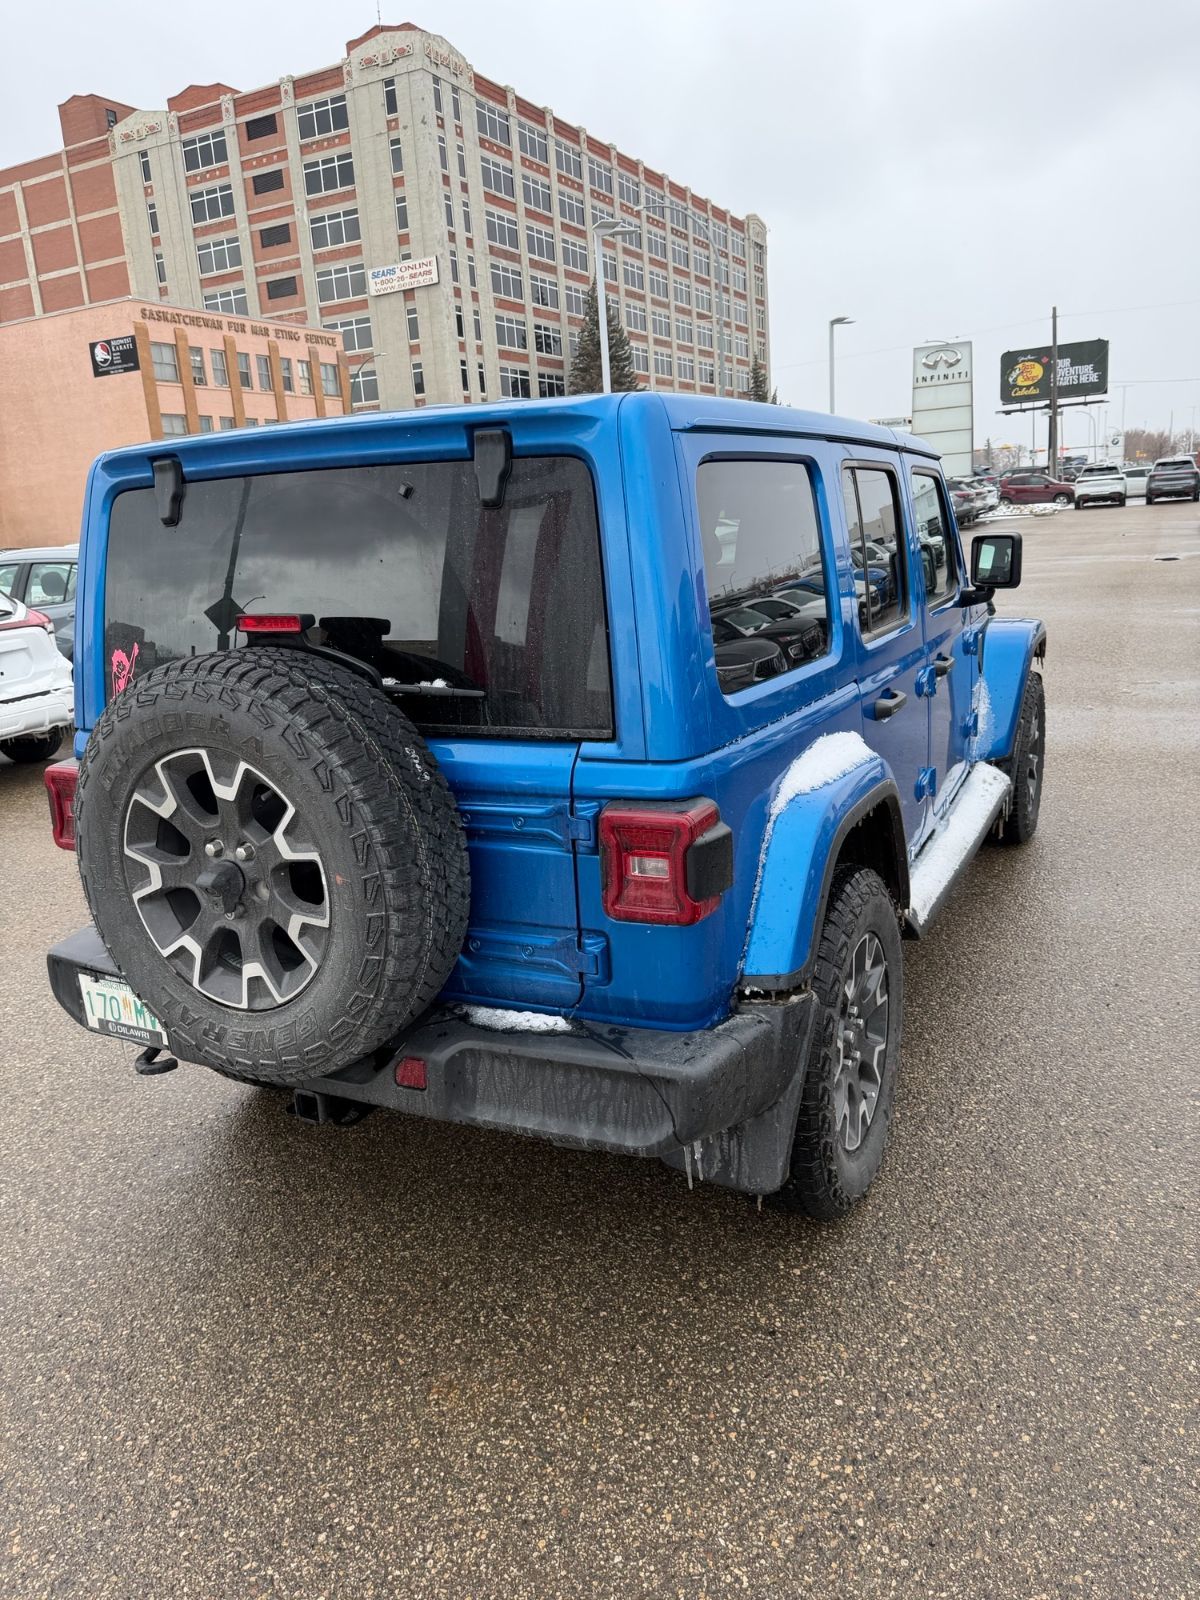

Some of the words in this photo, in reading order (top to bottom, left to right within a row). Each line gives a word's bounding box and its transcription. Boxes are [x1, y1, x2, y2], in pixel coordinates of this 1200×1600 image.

[400, 260, 433, 273] ONLINE
[140, 307, 223, 330] SASKATCHEWAN
[227, 321, 246, 334] FUR
[304, 333, 337, 347] SERVICE
[110, 337, 132, 346] MIDWEST
[111, 343, 134, 352] KARATE
[916, 371, 968, 383] INFINITI
[1080, 372, 1100, 384] HERE
[86, 990, 121, 1021] 170
[117, 1025, 150, 1039] DILAWRI
